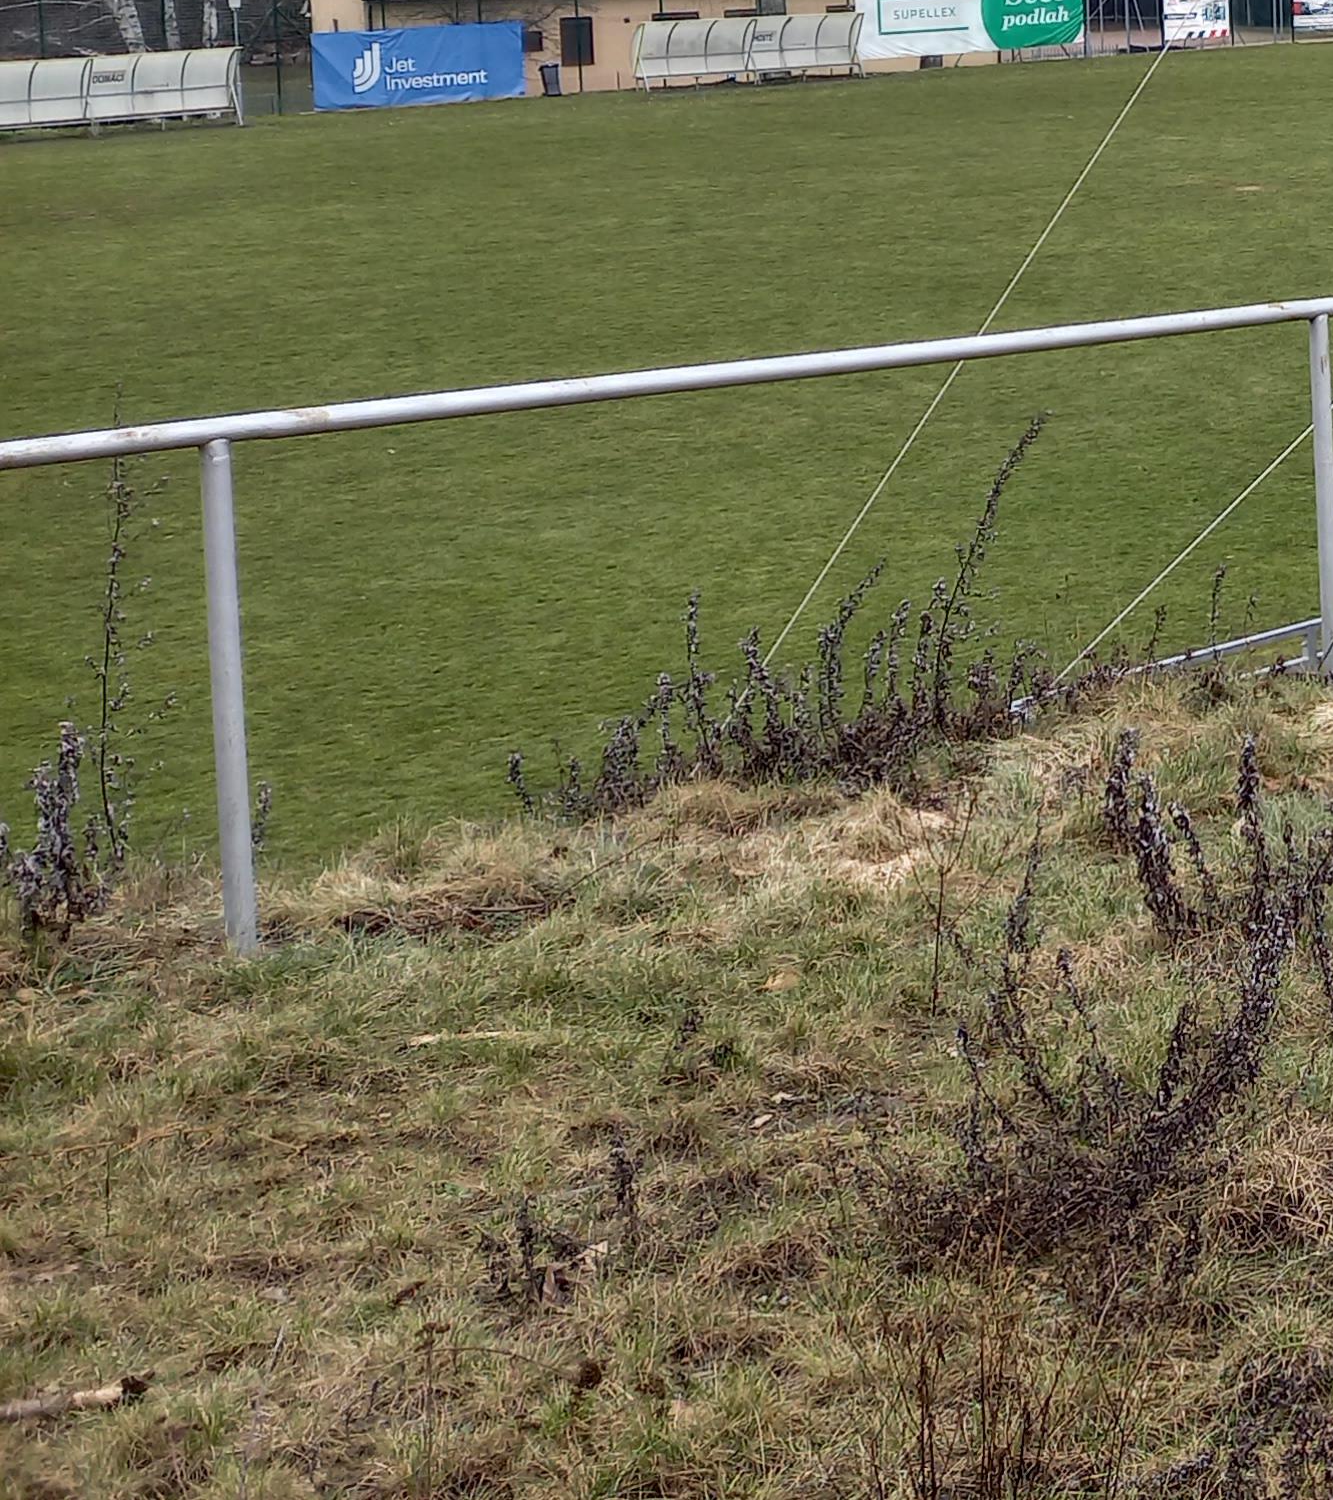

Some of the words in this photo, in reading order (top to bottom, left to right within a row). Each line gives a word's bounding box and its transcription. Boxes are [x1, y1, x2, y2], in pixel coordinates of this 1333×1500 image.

[892, 6, 956, 20] SUPELLEX
[1001, 5, 1070, 31] podlah
[384, 57, 416, 73] Jet
[385, 69, 488, 91] Investment
